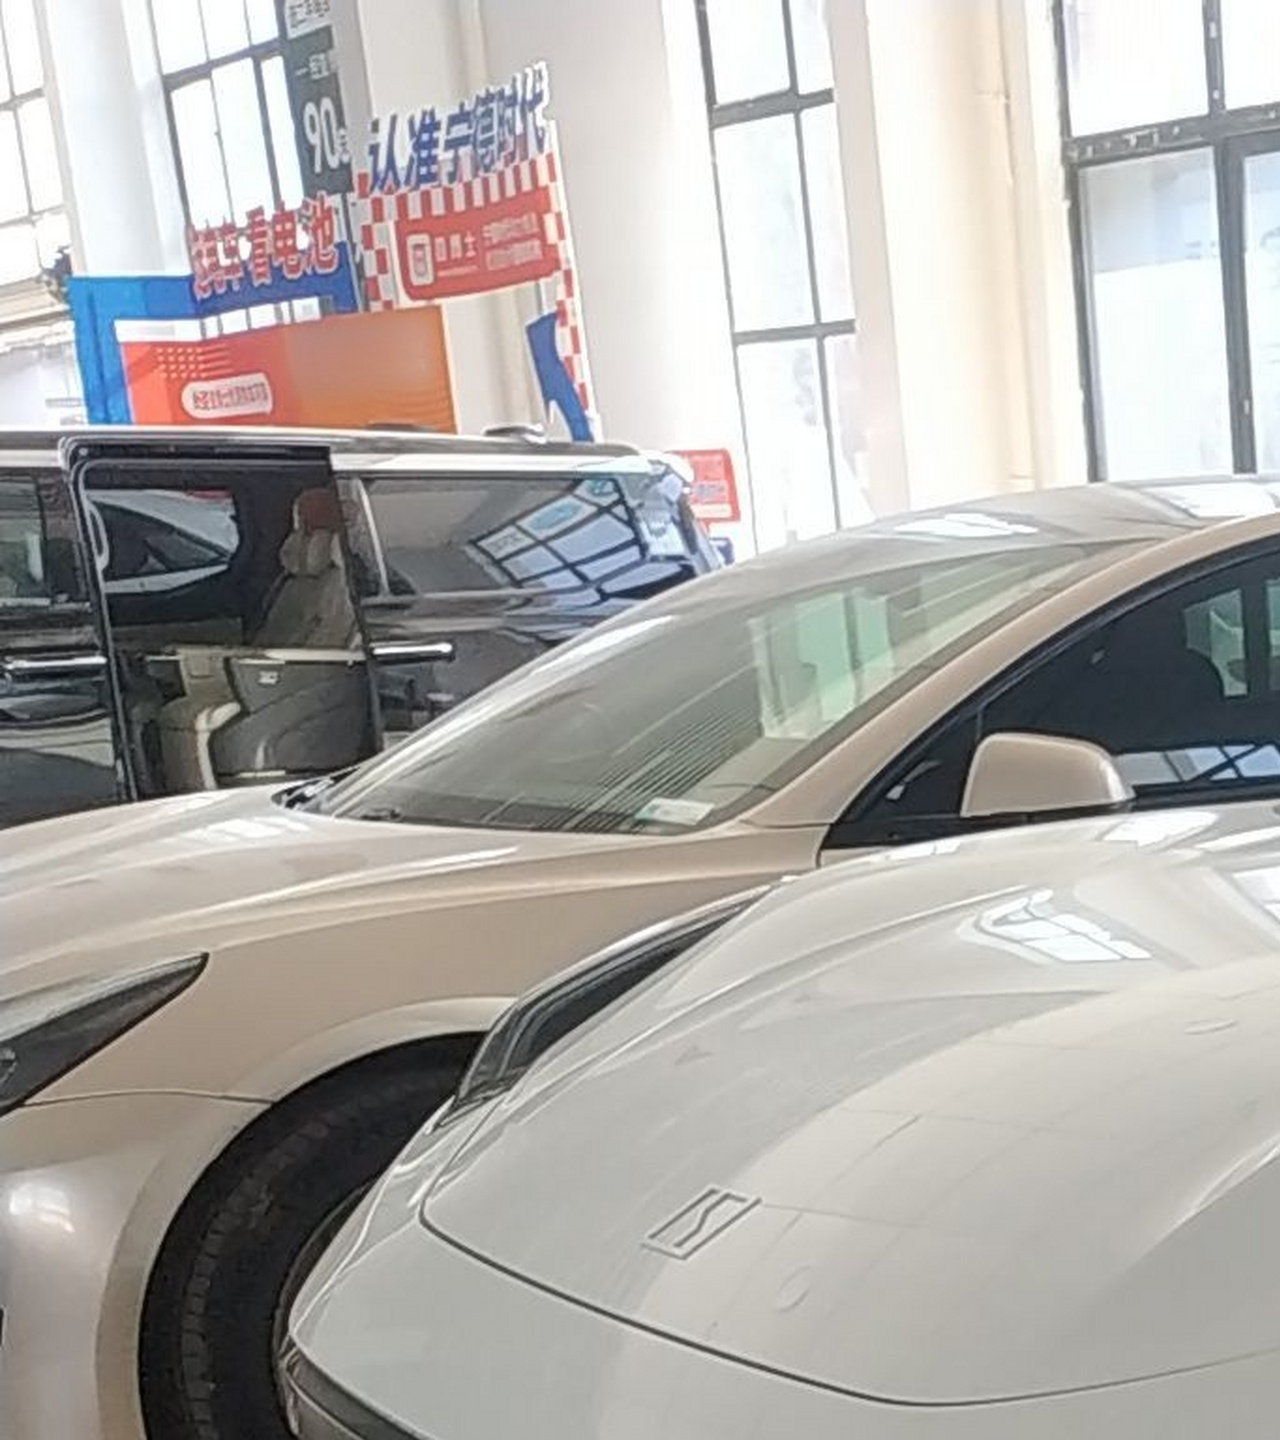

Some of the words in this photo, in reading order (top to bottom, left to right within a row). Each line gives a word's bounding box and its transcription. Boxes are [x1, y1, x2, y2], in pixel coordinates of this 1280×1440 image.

[368, 66, 547, 192] 认准宁德时代
